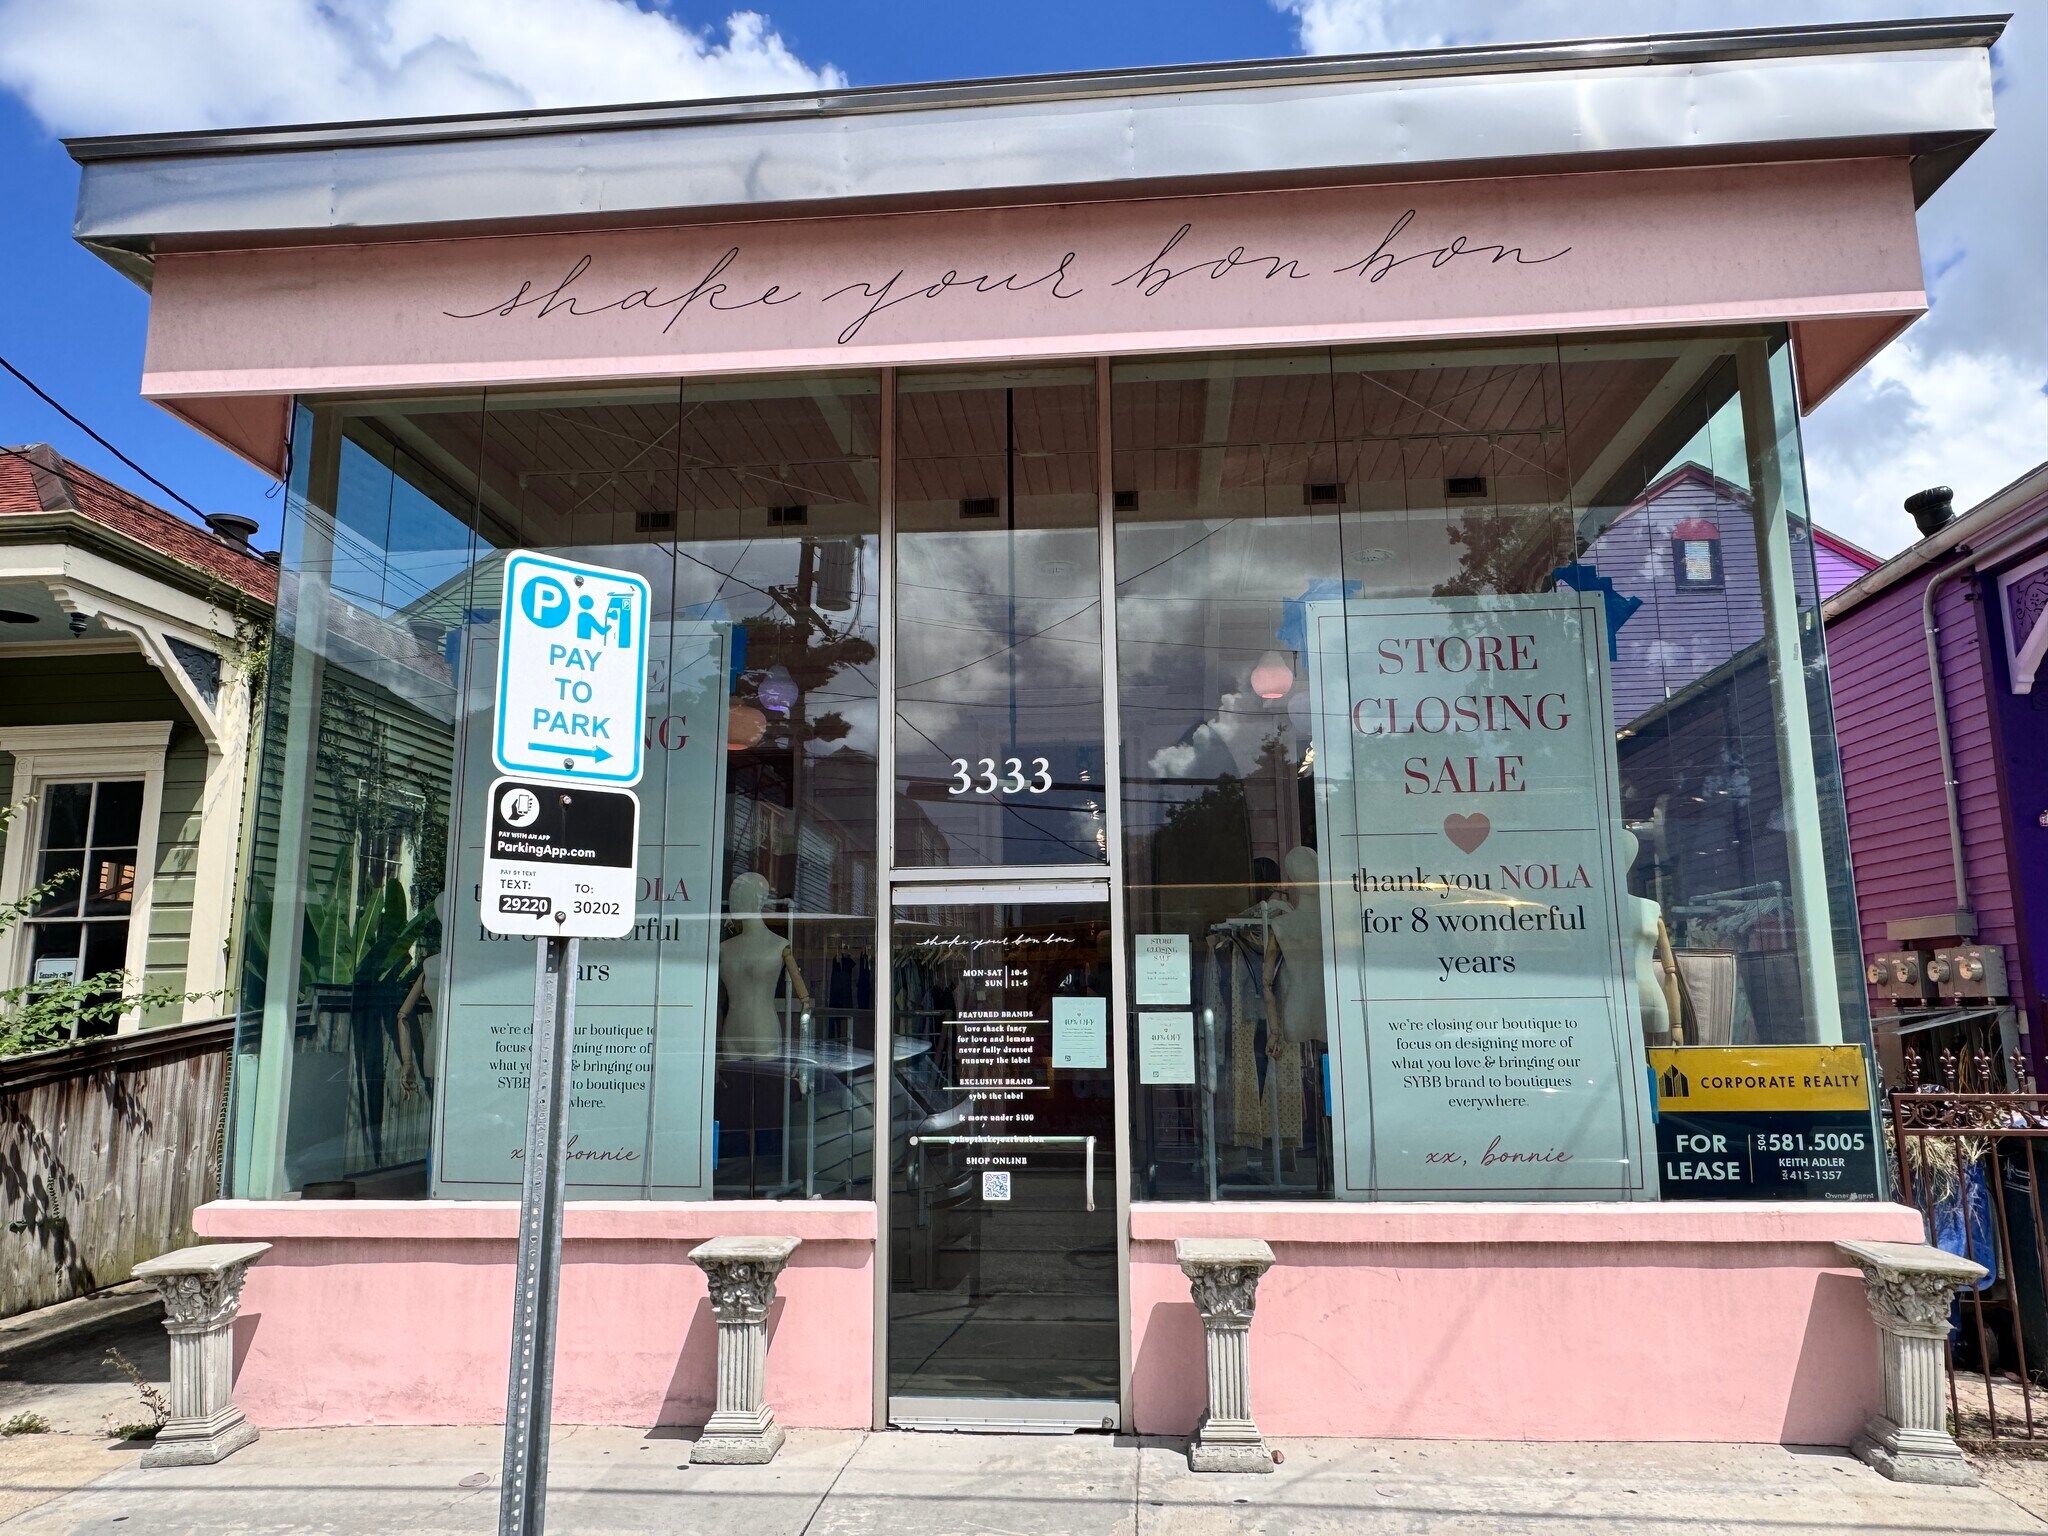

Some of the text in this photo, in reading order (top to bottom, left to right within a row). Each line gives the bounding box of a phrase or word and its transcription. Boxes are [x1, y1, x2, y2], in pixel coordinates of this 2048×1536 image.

[443, 209, 1572, 344] shake your bon bon
[549, 643, 603, 671] PAY
[1377, 634, 1539, 675] STORE
[555, 677, 593, 703] TO
[1352, 693, 1572, 735] CLOSING
[533, 707, 611, 739] PARK
[948, 757, 1053, 795] 3333
[1404, 755, 1526, 795] SALE
[497, 841, 596, 858] ParkingApp.com
[500, 879, 531, 890] TEXT:
[575, 884, 594, 894] TO:
[636, 877, 691, 901] OLA
[1351, 863, 1594, 899] thank you NOLA
[502, 897, 548, 913] 29220
[573, 901, 620, 915] 30202
[1361, 904, 1587, 934] for 8 wonderful
[963, 969, 1003, 977] MON-SAT
[1438, 954, 1516, 982] years
[985, 979, 1028, 987] SUN 11-6
[574, 1025, 588, 1035] ur
[590, 1023, 644, 1041] boutique
[964, 1024, 1027, 1034] love shack fancy
[1388, 1017, 1578, 1033] we're closing our boutique to
[495, 1041, 526, 1053] focus
[957, 1035, 969, 1043] for
[1396, 1036, 1574, 1051] focus on designing more of
[605, 1044, 637, 1054] more
[639, 1043, 653, 1054] of
[489, 1060, 517, 1071] what
[583, 1060, 633, 1075] bringing
[996, 1056, 1009, 1064] the
[1011, 1056, 1031, 1064] label
[1391, 1055, 1581, 1072] what you love & bringing our
[572, 1077, 646, 1094] to boutiques
[1403, 1074, 1572, 1090] SYBB brand to boutiques
[1701, 1075, 1860, 1089] CORPORATE REALTY
[989, 1092, 1002, 1100] the
[1004, 1092, 1024, 1100] label
[990, 1113, 1014, 1121] under
[1015, 1113, 1034, 1121] $100
[1676, 1134, 1728, 1153] FOR
[1757, 1133, 1865, 1151] 504 581.5005
[1480, 1135, 1574, 1166] bonnie
[966, 1156, 1028, 1165] SHOP ONLINE
[1779, 1157, 1846, 1167] KEITH ADLER
[1666, 1161, 1741, 1180] LEASE
[1790, 1170, 1842, 1180] 415-1357
